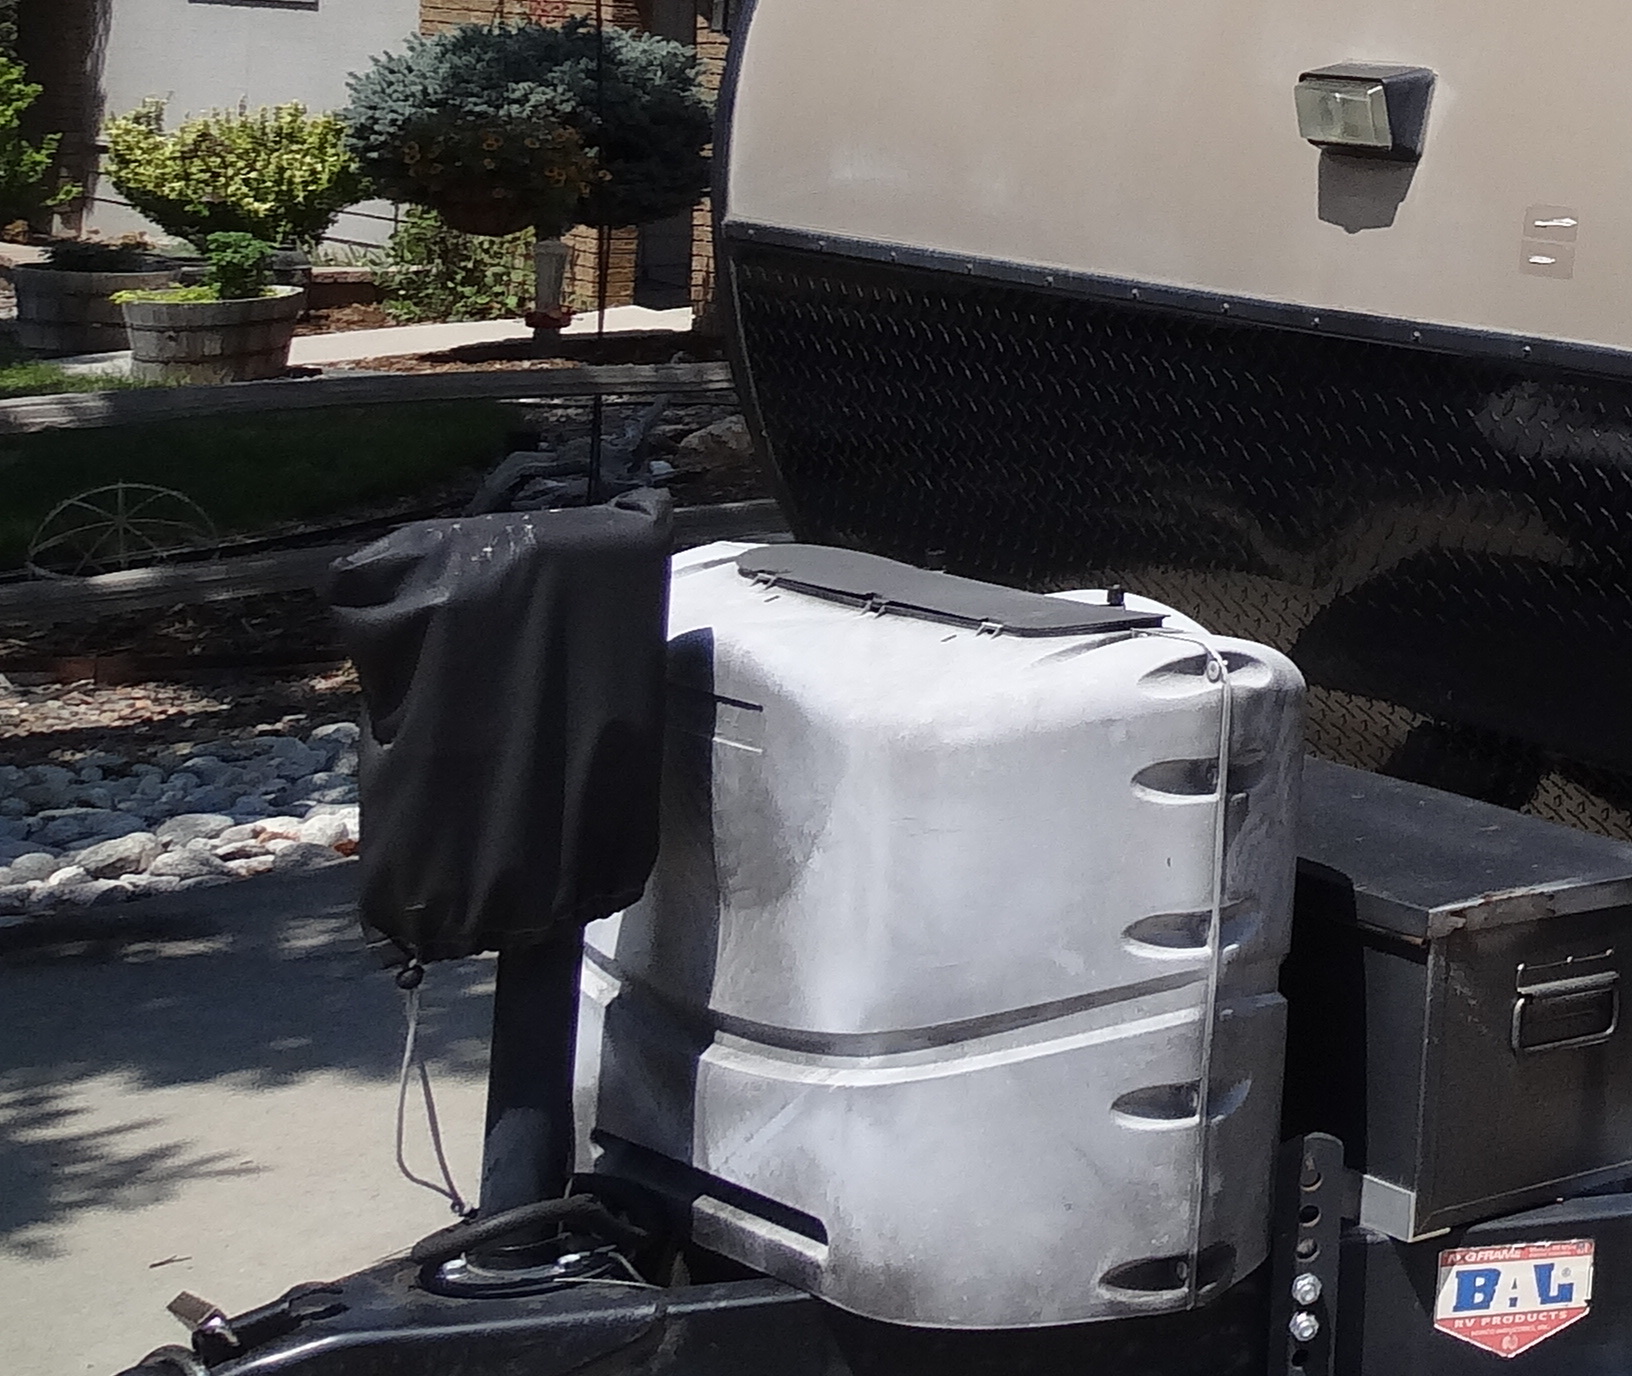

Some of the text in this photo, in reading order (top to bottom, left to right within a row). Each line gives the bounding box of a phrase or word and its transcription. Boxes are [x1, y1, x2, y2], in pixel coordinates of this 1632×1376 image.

[1452, 1262, 1575, 1313] BAL
[1453, 1310, 1569, 1329] RV PRODUCTS
